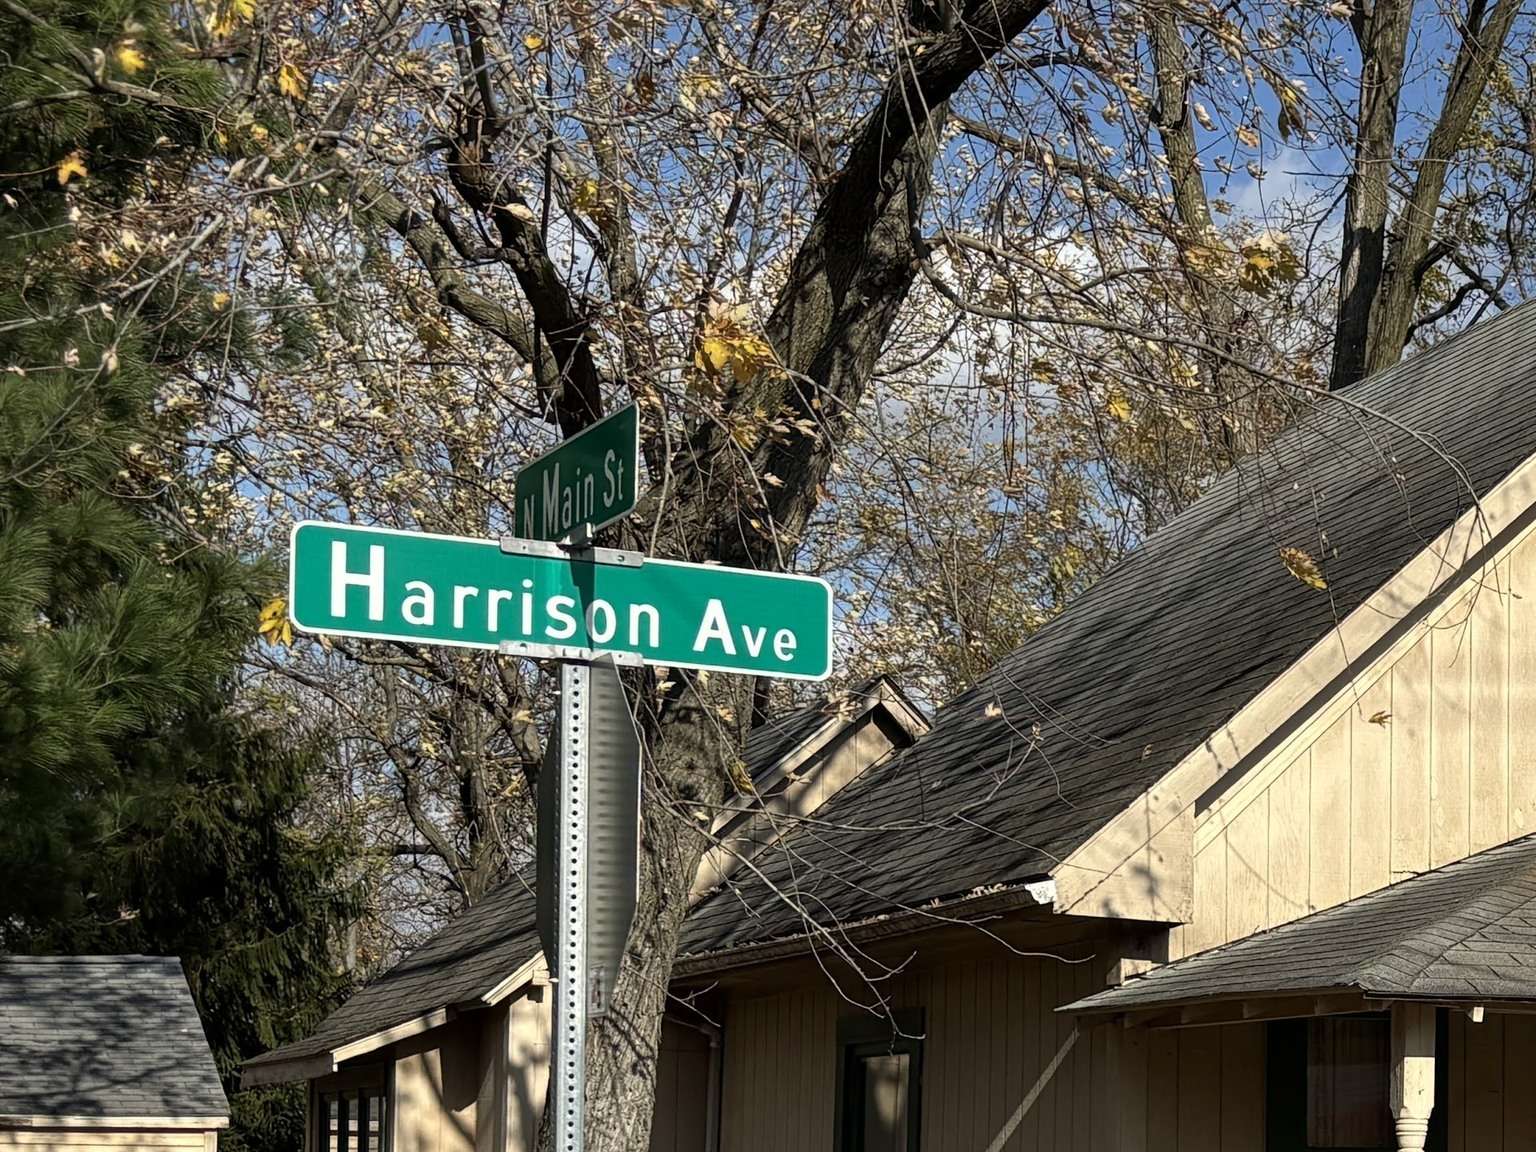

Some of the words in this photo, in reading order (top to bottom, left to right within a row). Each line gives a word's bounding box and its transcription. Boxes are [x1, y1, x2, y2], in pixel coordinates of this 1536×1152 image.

[523, 494, 535, 540] N
[542, 461, 595, 540] Main
[602, 447, 625, 508] St
[330, 540, 660, 649] Harrison
[692, 598, 798, 662] Ave
